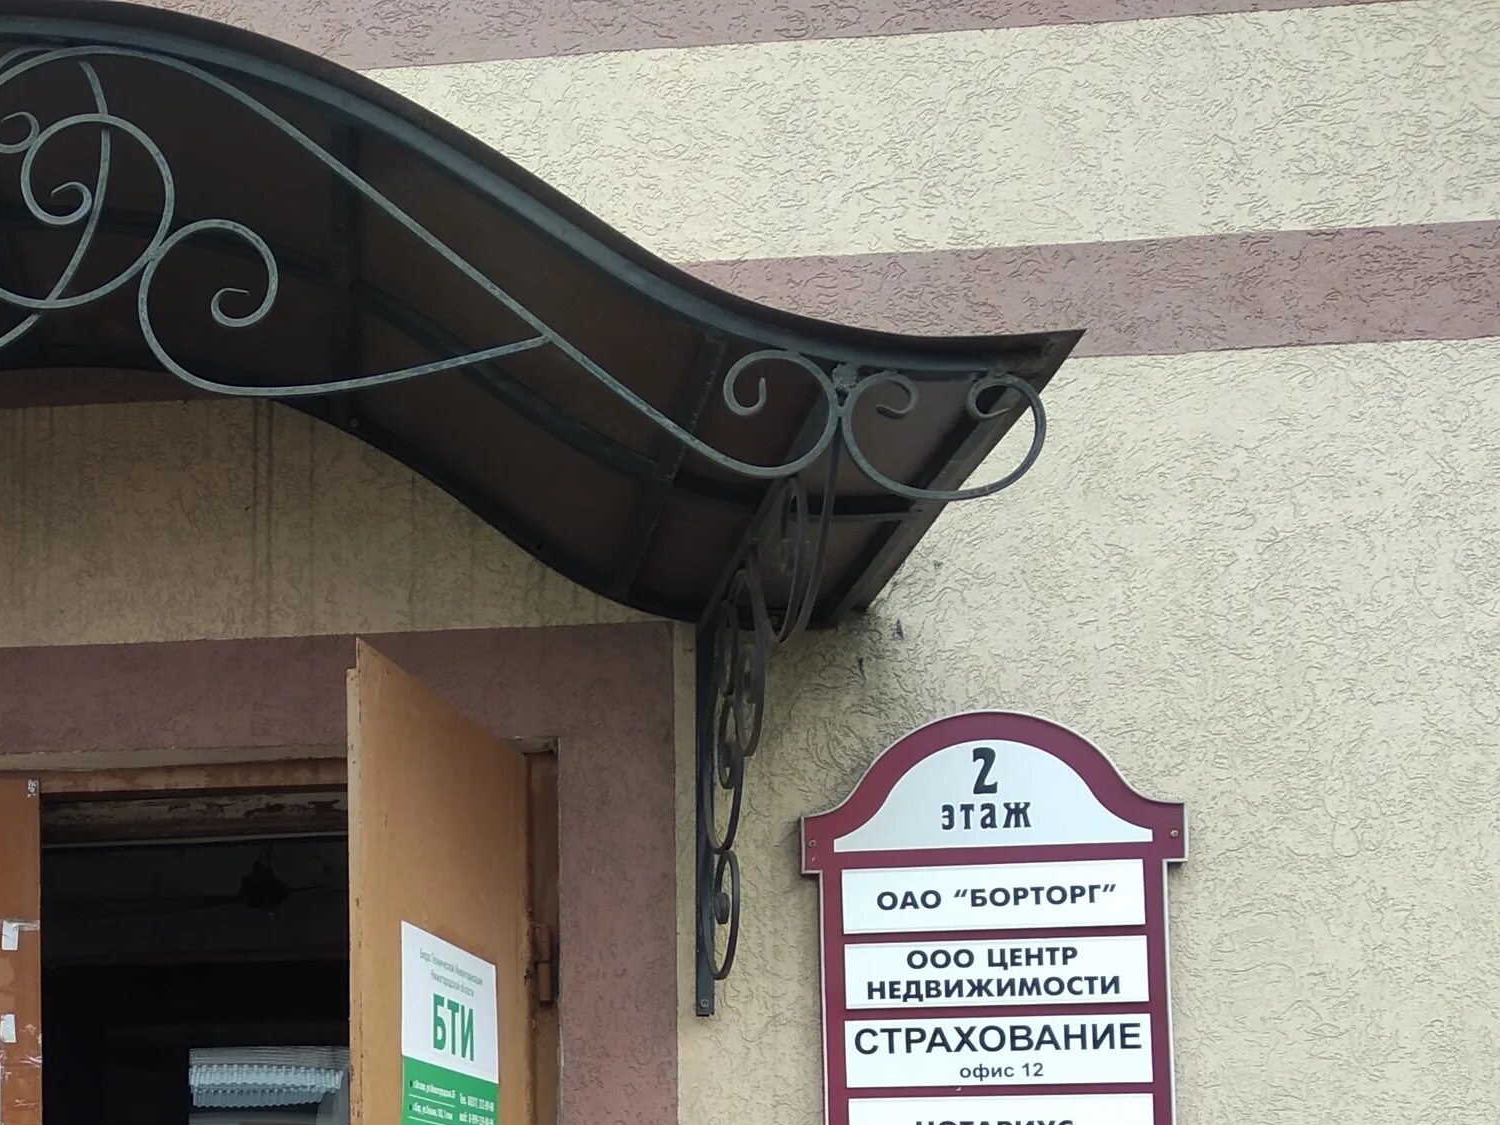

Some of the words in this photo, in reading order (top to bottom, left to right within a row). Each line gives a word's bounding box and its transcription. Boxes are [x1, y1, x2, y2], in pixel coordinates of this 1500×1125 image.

[972, 747, 998, 795] 2
[941, 801, 1031, 831] этаж
[877, 889, 942, 911] ОАО
[906, 949, 975, 969] ООО
[987, 947, 1078, 970] ЦЕНТР
[867, 975, 1121, 1002] НЕДВИЖИМОСТИ
[432, 993, 475, 1061] БТИ
[854, 1022, 1142, 1055] СТРАХОВАНИЕ
[959, 1063, 1015, 1081] офис
[1021, 1062, 1045, 1078] 12
